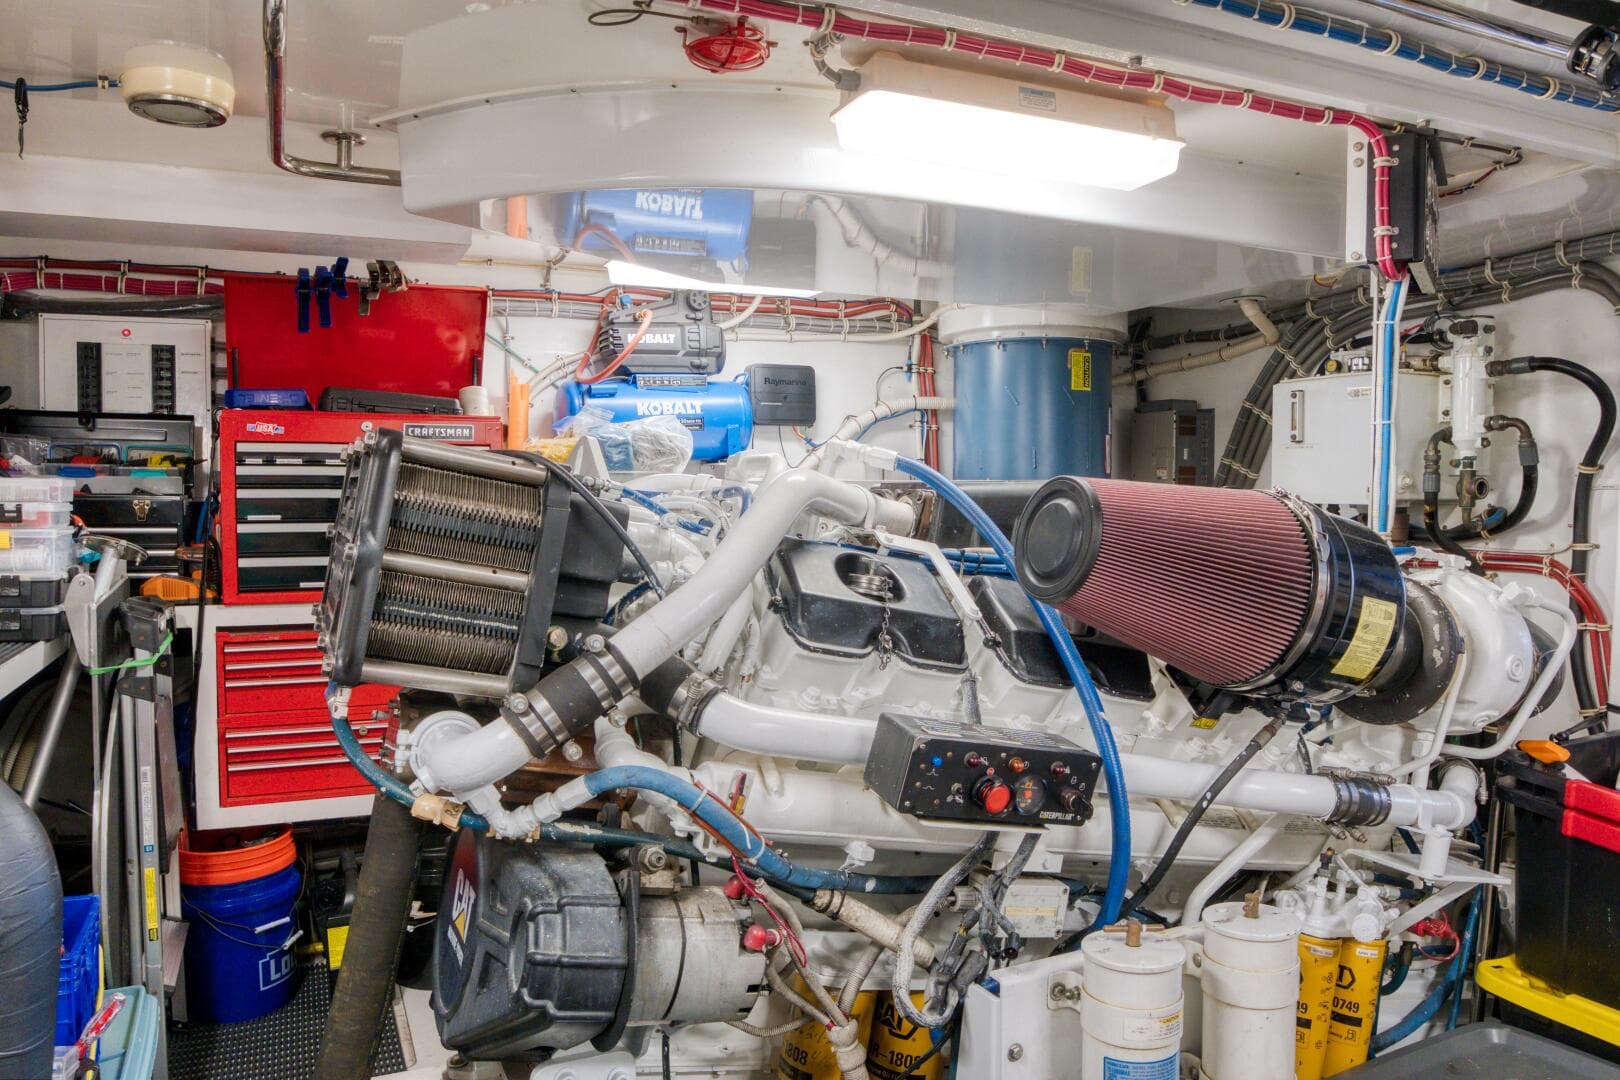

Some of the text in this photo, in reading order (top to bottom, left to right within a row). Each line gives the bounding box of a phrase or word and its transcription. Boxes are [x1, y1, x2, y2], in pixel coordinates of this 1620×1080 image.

[764, 377, 807, 388] Raymarine
[637, 400, 704, 415] KOBALT
[408, 427, 471, 437] CRAFTSMAN
[452, 867, 477, 945] CAT
